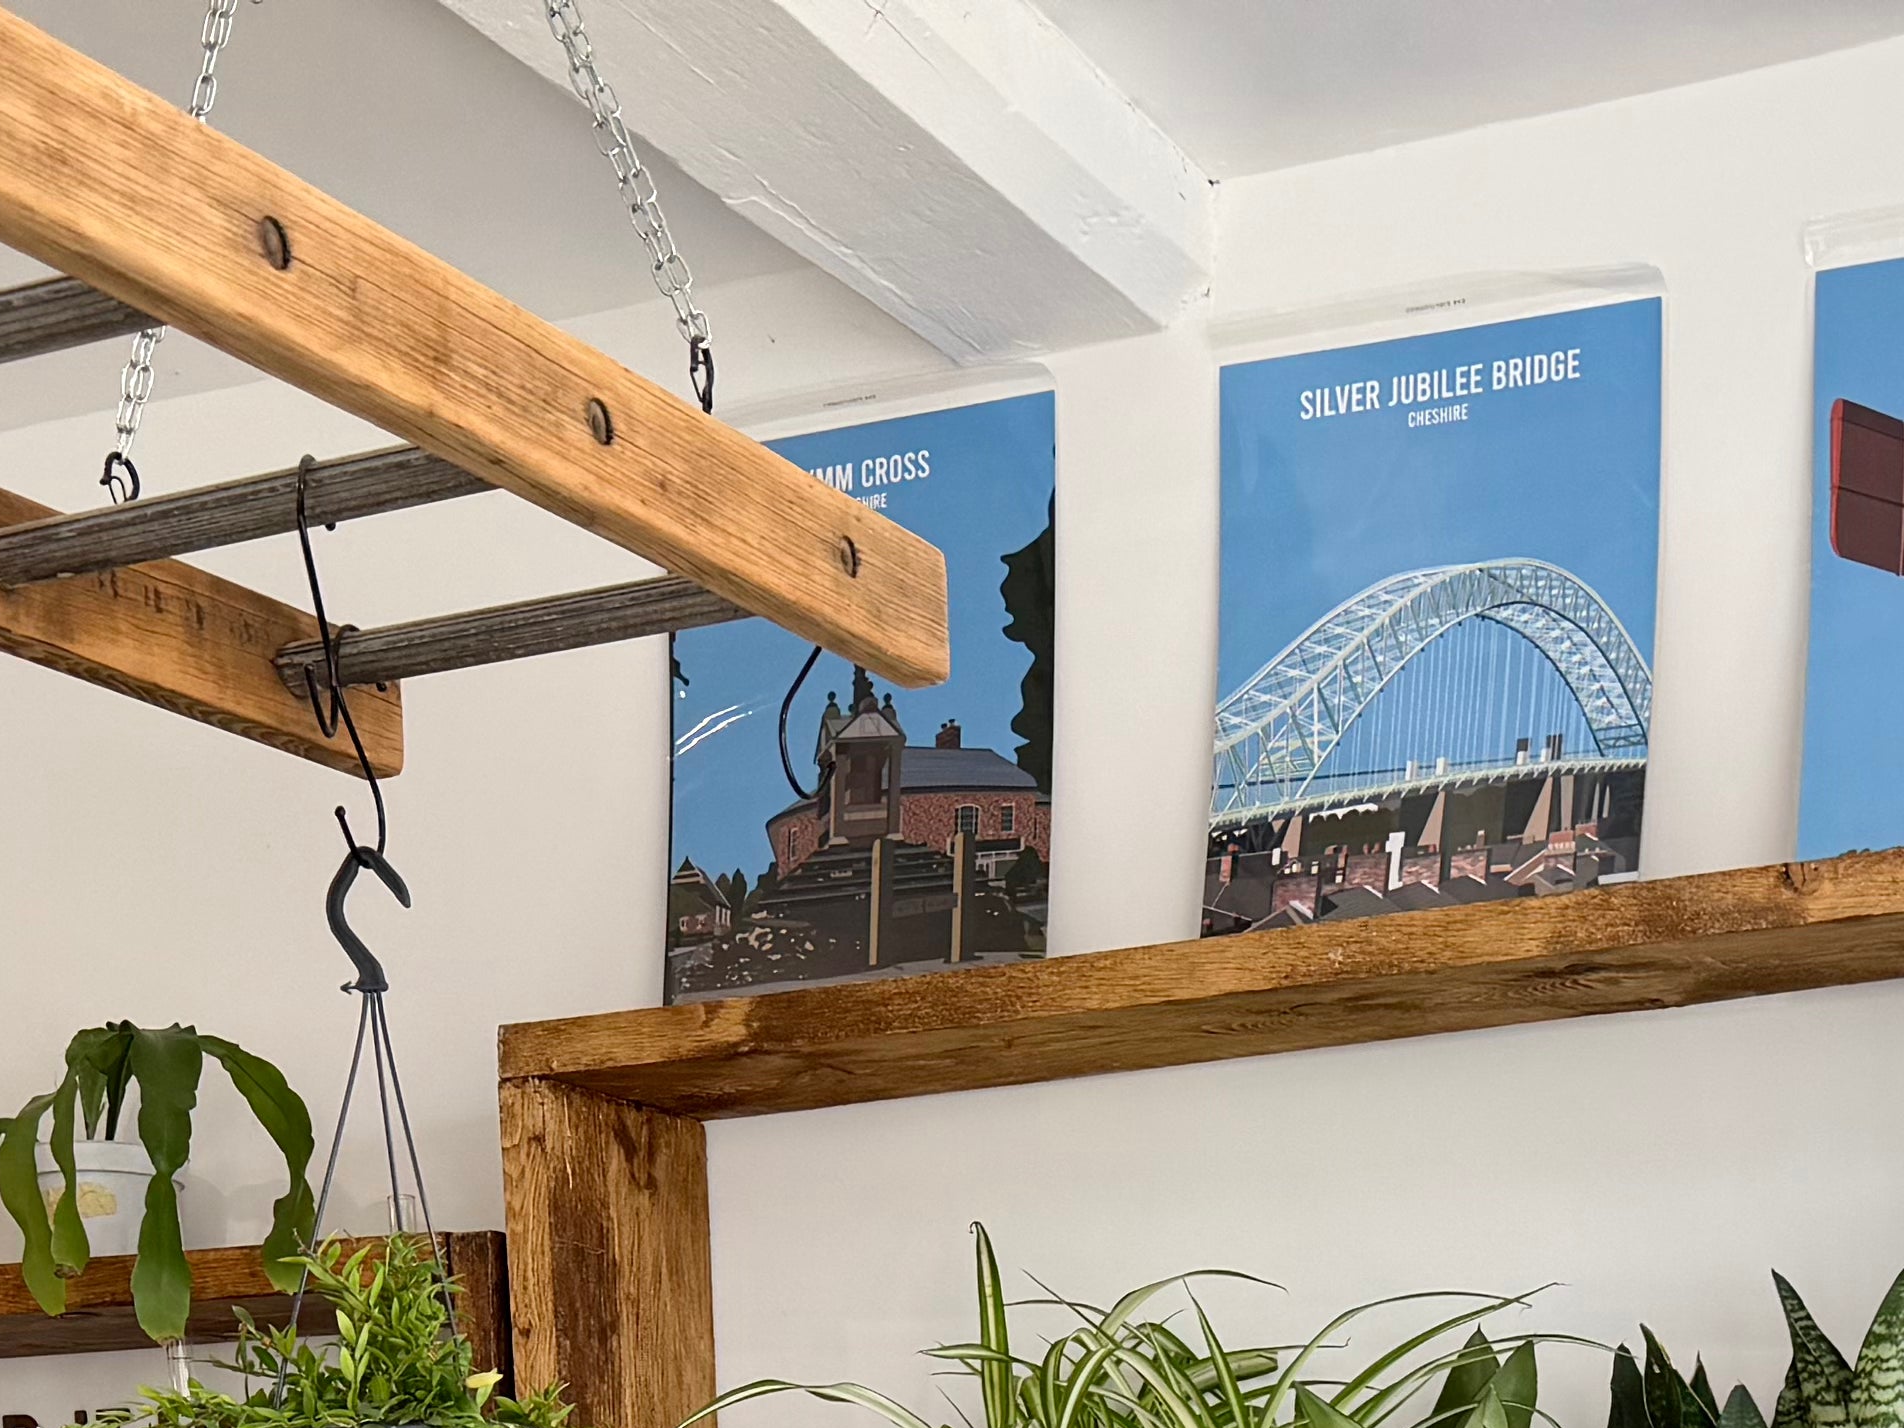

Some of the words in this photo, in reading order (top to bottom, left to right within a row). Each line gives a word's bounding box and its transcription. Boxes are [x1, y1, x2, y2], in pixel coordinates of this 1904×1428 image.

[1300, 379, 1381, 421] SILVER
[1388, 363, 1484, 408] JUBILEE
[1492, 348, 1581, 391] BRIDGE
[1408, 403, 1469, 428] CHESHIRE
[861, 450, 930, 488] CROSS
